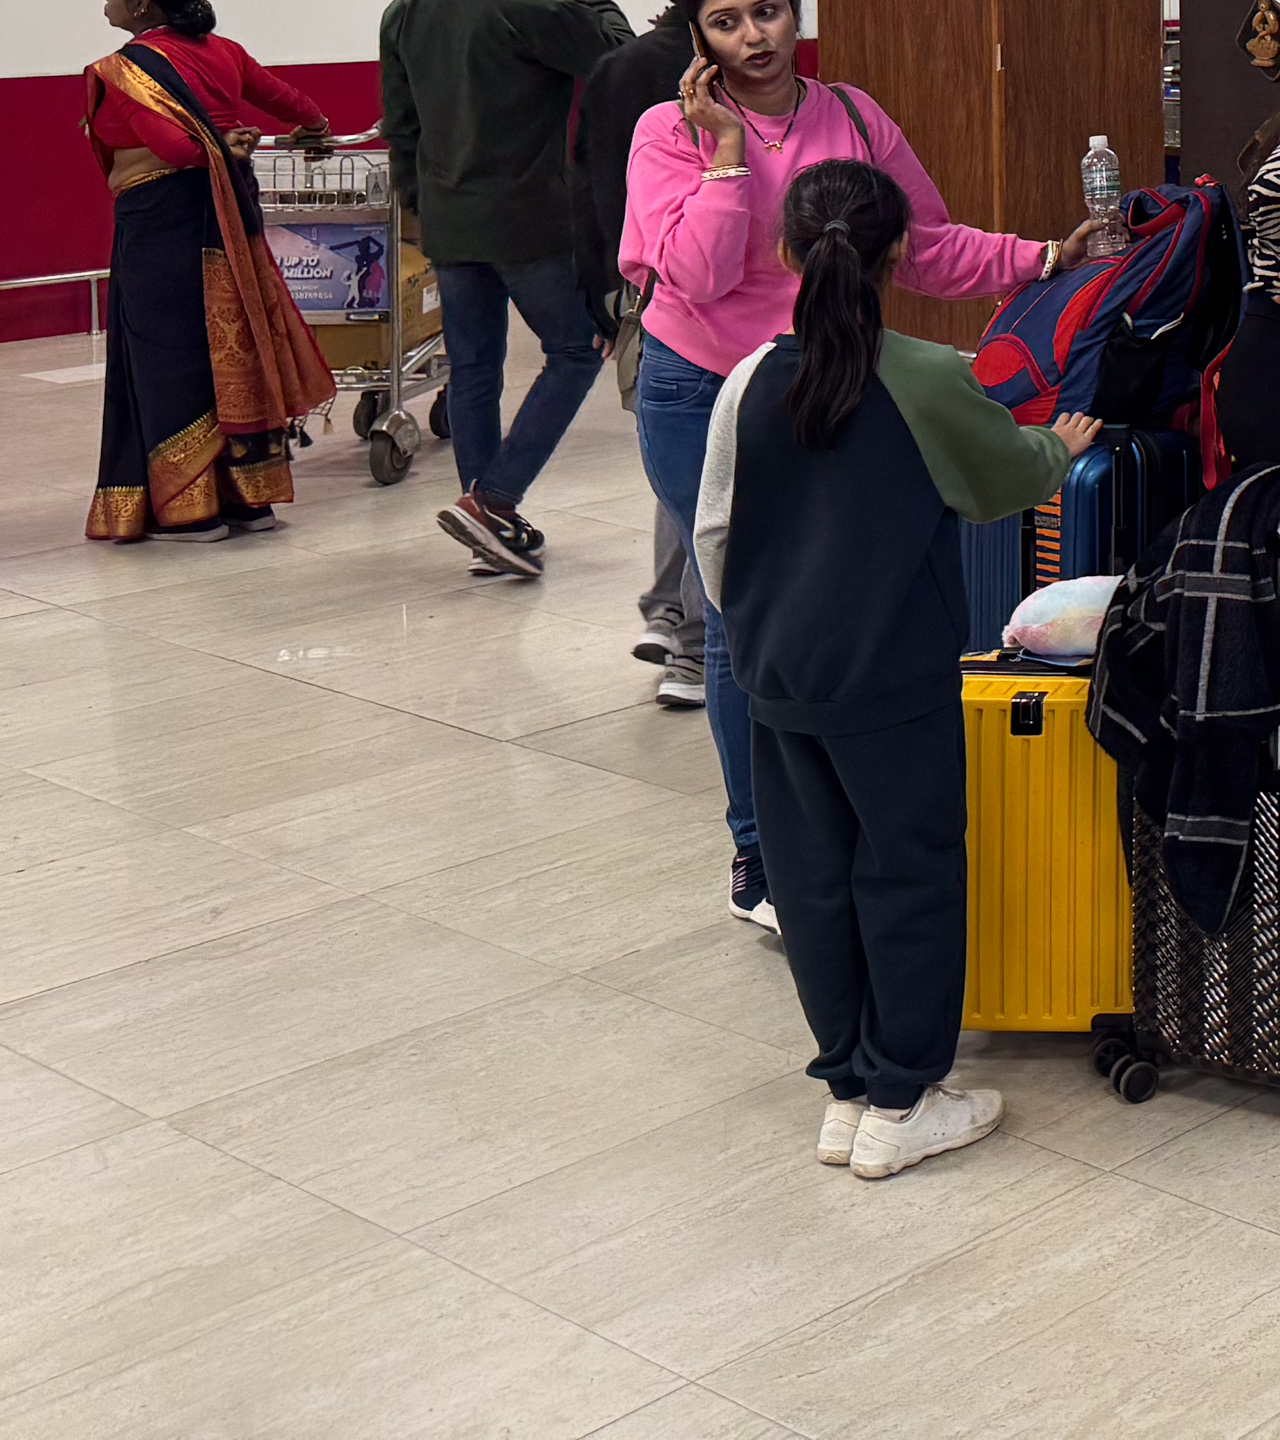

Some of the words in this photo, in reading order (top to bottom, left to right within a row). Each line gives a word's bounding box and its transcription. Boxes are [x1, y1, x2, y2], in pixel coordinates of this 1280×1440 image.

[284, 256, 301, 268] UP
[302, 255, 319, 268] TO
[284, 267, 333, 279] MILLION
